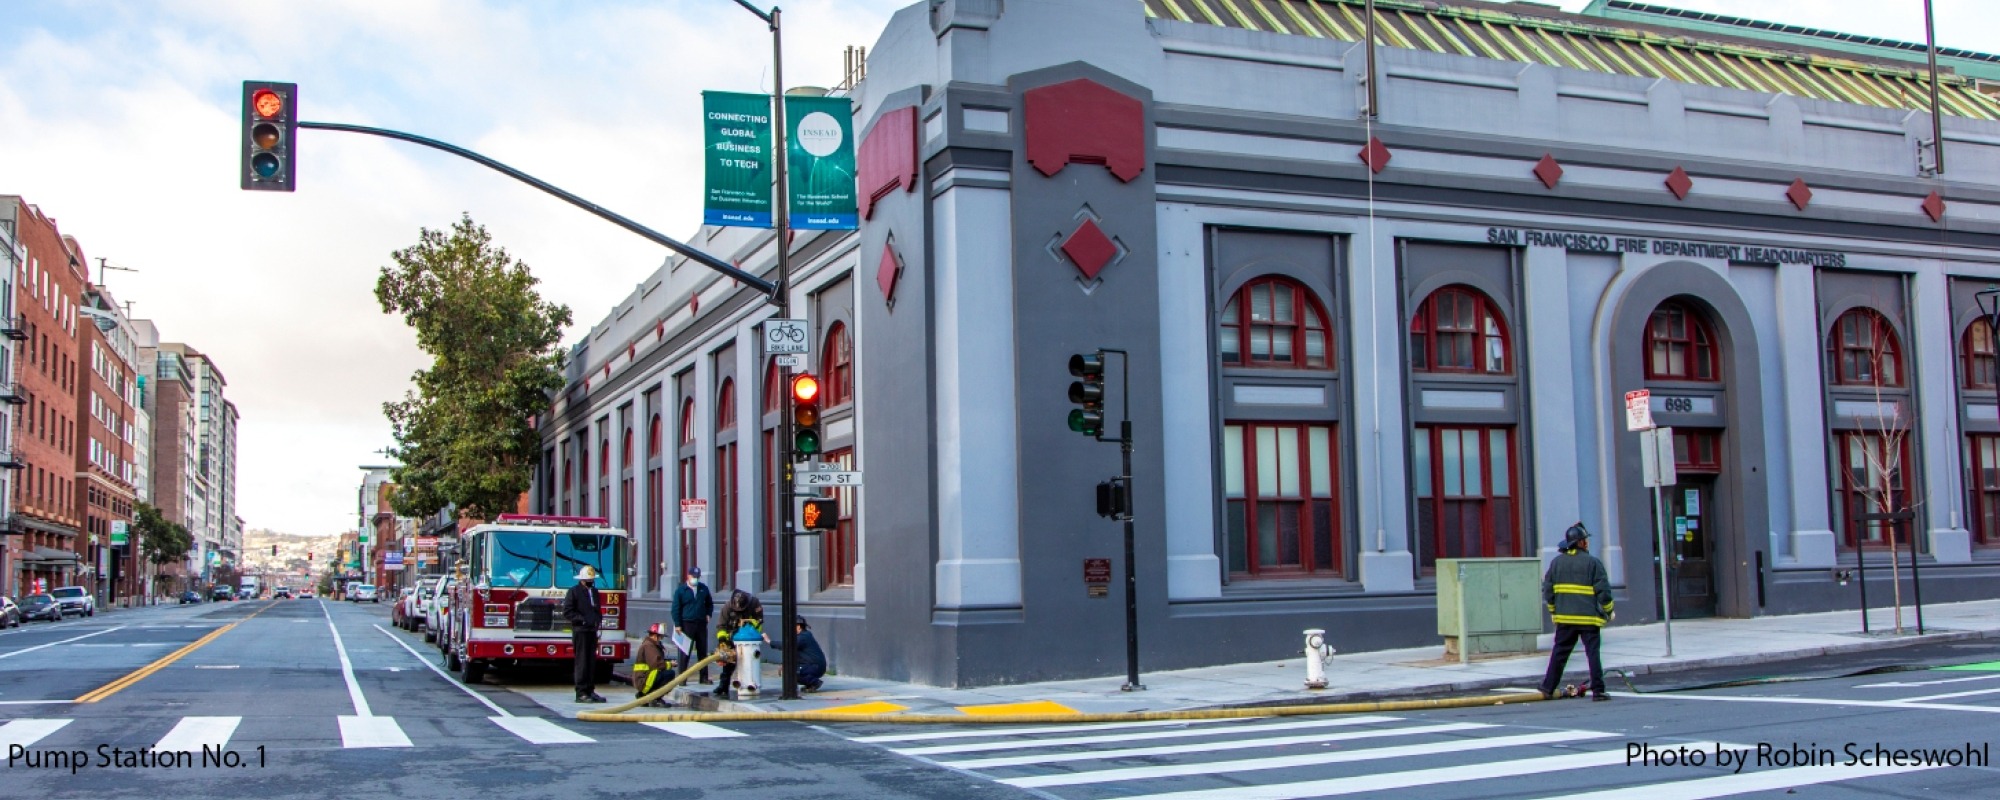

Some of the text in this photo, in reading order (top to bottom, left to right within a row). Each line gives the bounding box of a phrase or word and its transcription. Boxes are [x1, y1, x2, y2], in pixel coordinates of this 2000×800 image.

[708, 111, 768, 124] CONNECTING
[721, 127, 757, 139] GLOBAL
[803, 129, 838, 137] INSEAD
[715, 142, 761, 154] BUSINESS
[720, 158, 758, 169] TO TECH
[722, 213, 754, 222] insead.edu
[1487, 227, 1847, 268] SAN FRANCISCO FIRE DEPARTMENT HEADQUARTERS
[787, 344, 804, 352] LANE
[1665, 397, 1693, 412] 698
[809, 474, 852, 484] 2ND ST
[606, 593, 620, 605] E8
